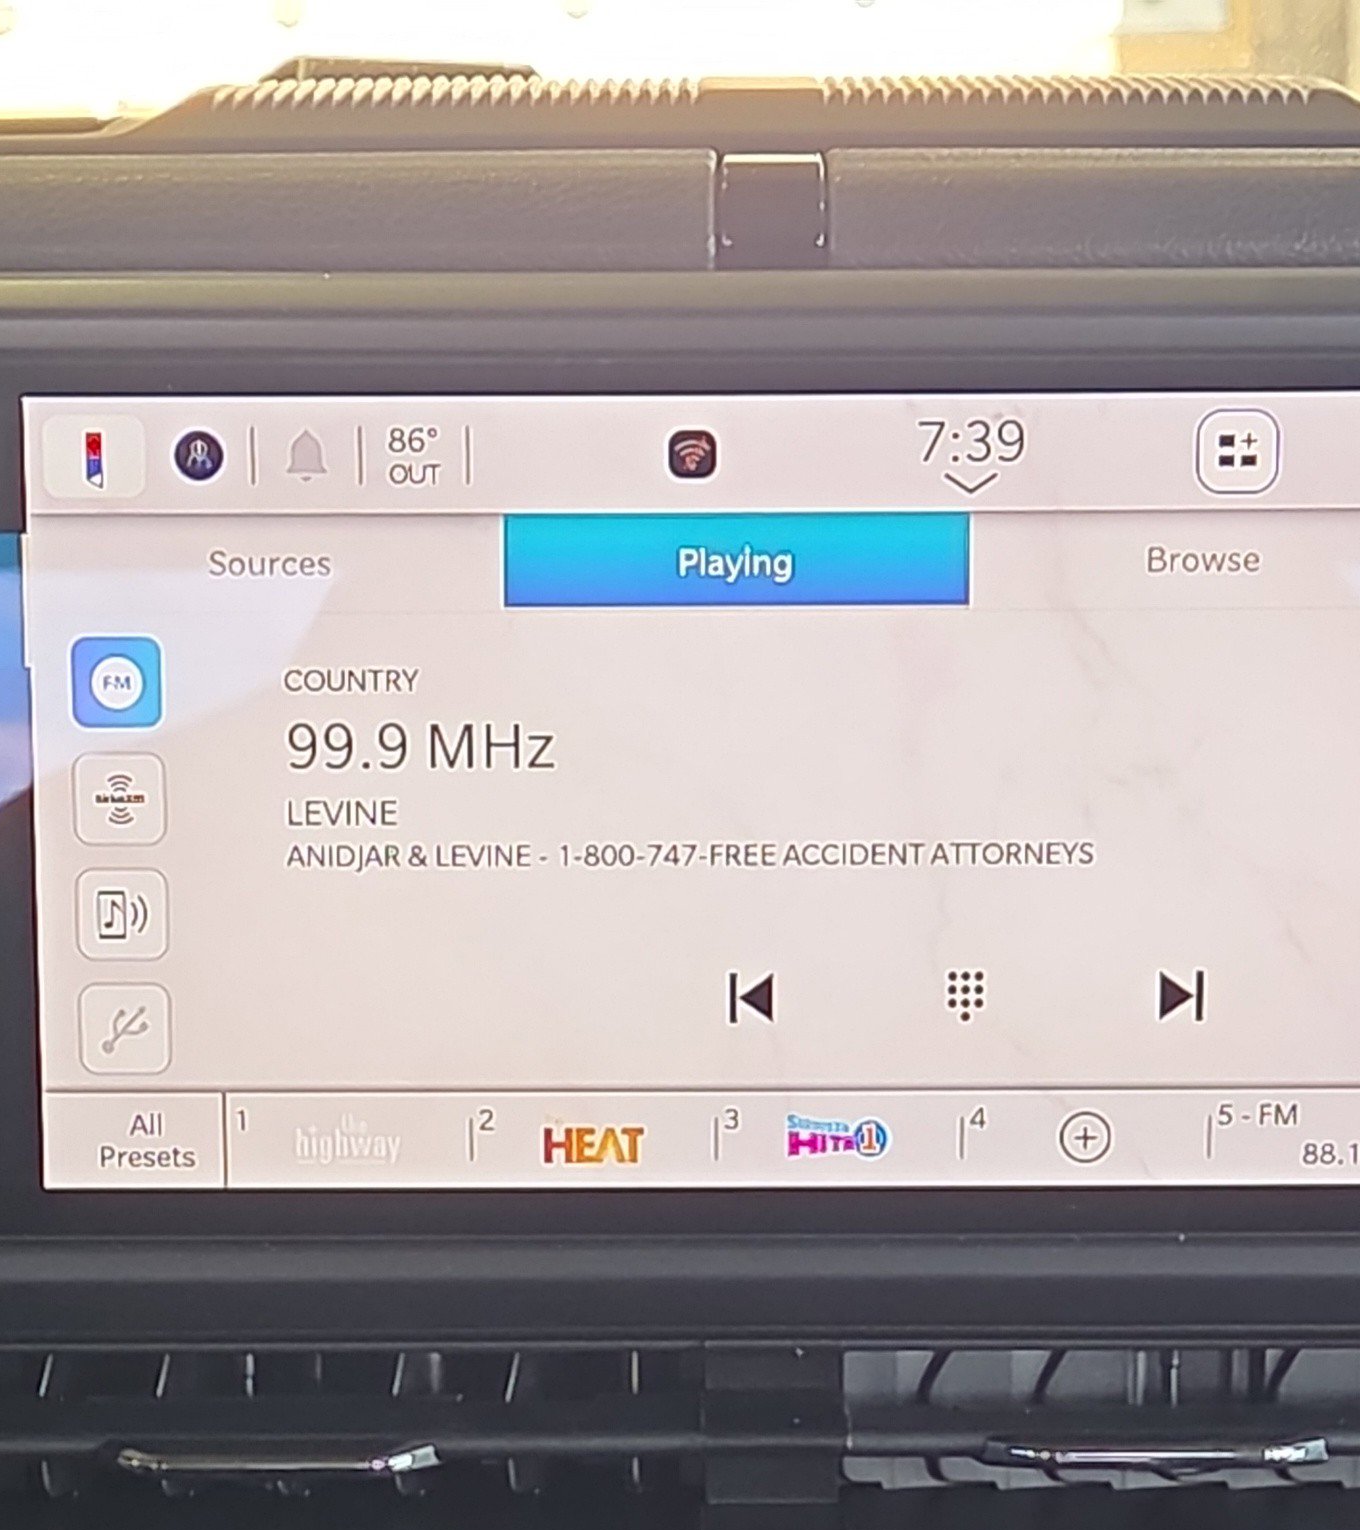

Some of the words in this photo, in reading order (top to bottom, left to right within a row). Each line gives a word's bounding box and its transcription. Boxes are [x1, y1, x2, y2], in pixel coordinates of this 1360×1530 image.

[388, 427, 439, 453] 86°
[917, 419, 1025, 464] 7:39
[388, 464, 441, 486] OUT
[208, 551, 332, 578] Sources
[678, 545, 794, 585] Playing
[1146, 545, 1261, 575] Browse
[102, 674, 132, 691] FM
[283, 668, 419, 693] COUNTRY
[287, 722, 408, 770] 99.9
[428, 722, 556, 770] MHz
[286, 800, 397, 827] LEVINE
[286, 842, 403, 872] ANIDJAR
[408, 843, 428, 868] &
[435, 843, 532, 867] LEVINE
[559, 842, 778, 867] 1-800-747-FREE
[783, 842, 927, 867] ACCIDENT
[930, 841, 1095, 866] ATTORNEYS
[129, 1112, 163, 1137] All
[236, 1110, 247, 1132] 1
[477, 1109, 495, 1131] 2
[723, 1109, 740, 1130] 3
[969, 1107, 987, 1129] 4
[1217, 1105, 1233, 1126] 5
[1258, 1104, 1298, 1125] FM
[100, 1144, 196, 1170] Presets
[295, 1126, 402, 1165] highway
[543, 1126, 645, 1164] HEAT
[1302, 1143, 1360, 1165] 88.1
